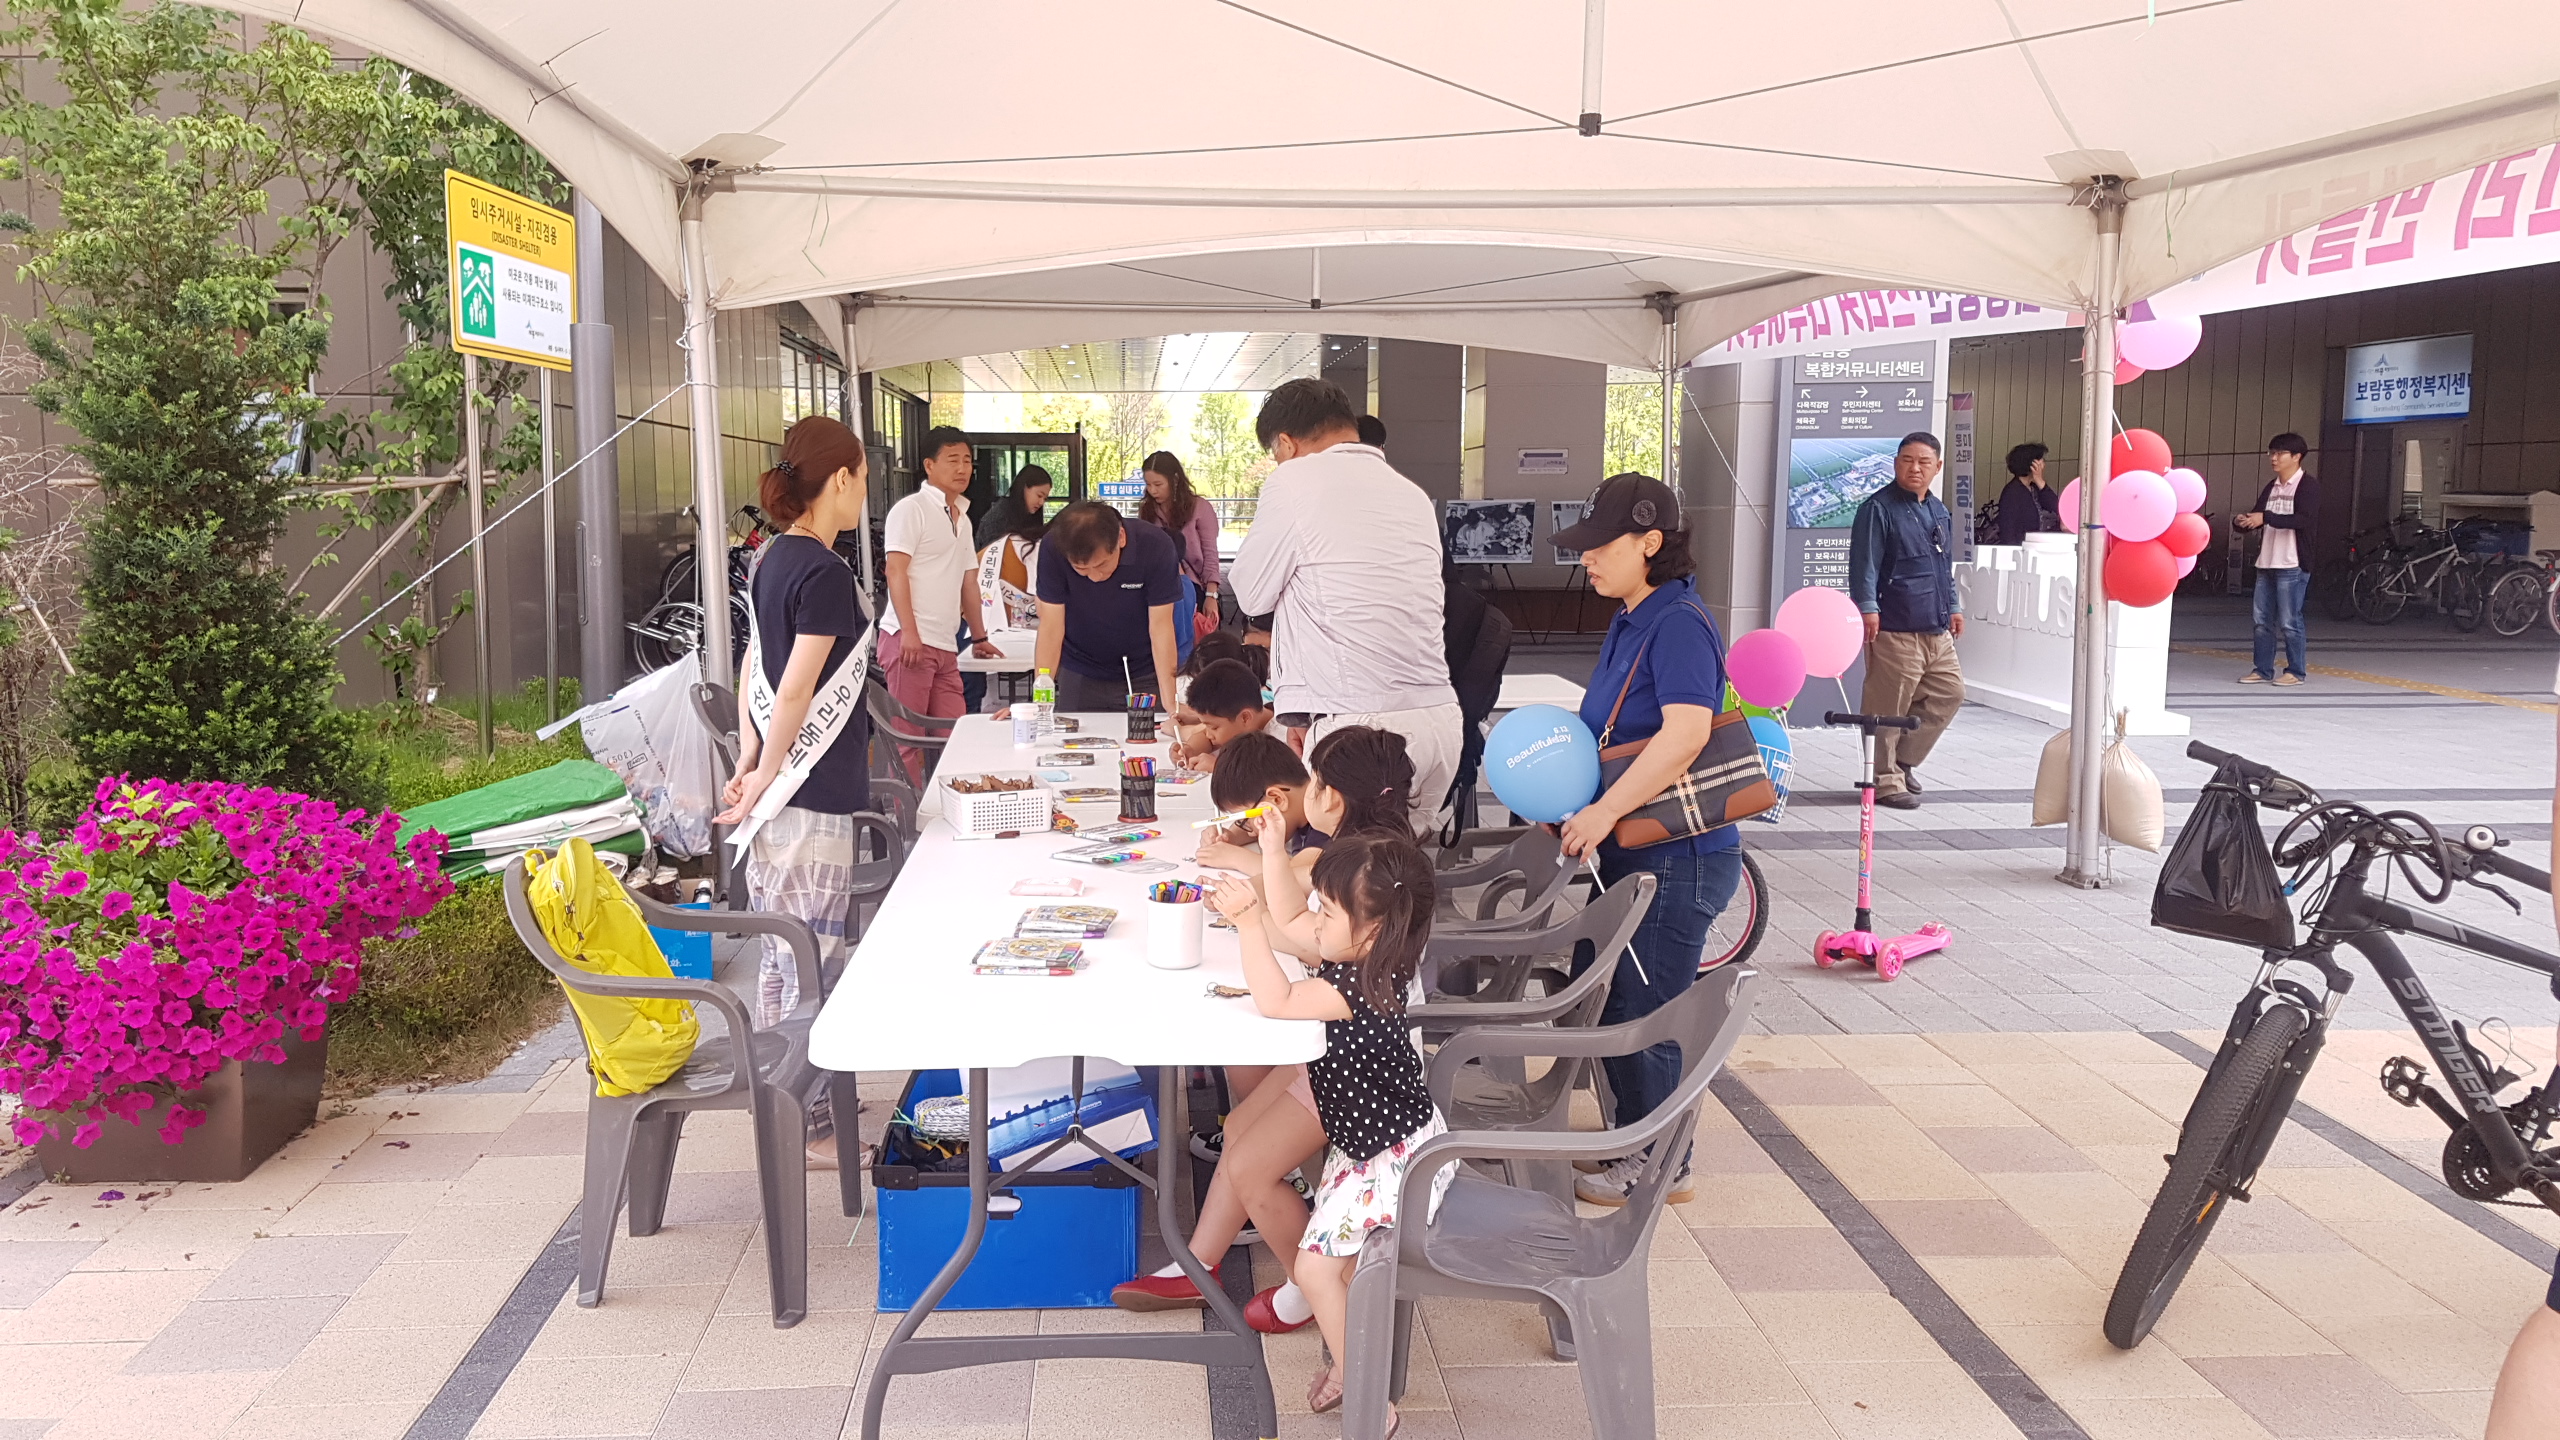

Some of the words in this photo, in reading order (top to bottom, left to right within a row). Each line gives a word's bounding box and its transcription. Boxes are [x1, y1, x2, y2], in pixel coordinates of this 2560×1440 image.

[1804, 361, 1924, 379] 복합커뮤니티센터
[1842, 401, 1881, 409] 주민자치센터
[1897, 399, 1924, 407] 보육시설
[1804, 539, 1811, 547] A
[1804, 552, 1811, 560] B
[1815, 551, 1845, 560] 보육시설
[981, 546, 999, 589] 우리동네
[1803, 565, 1810, 573] C
[1815, 578, 1844, 587] 생태연못
[787, 685, 851, 769] 우리동네
[2393, 976, 2499, 1114] STINGER
